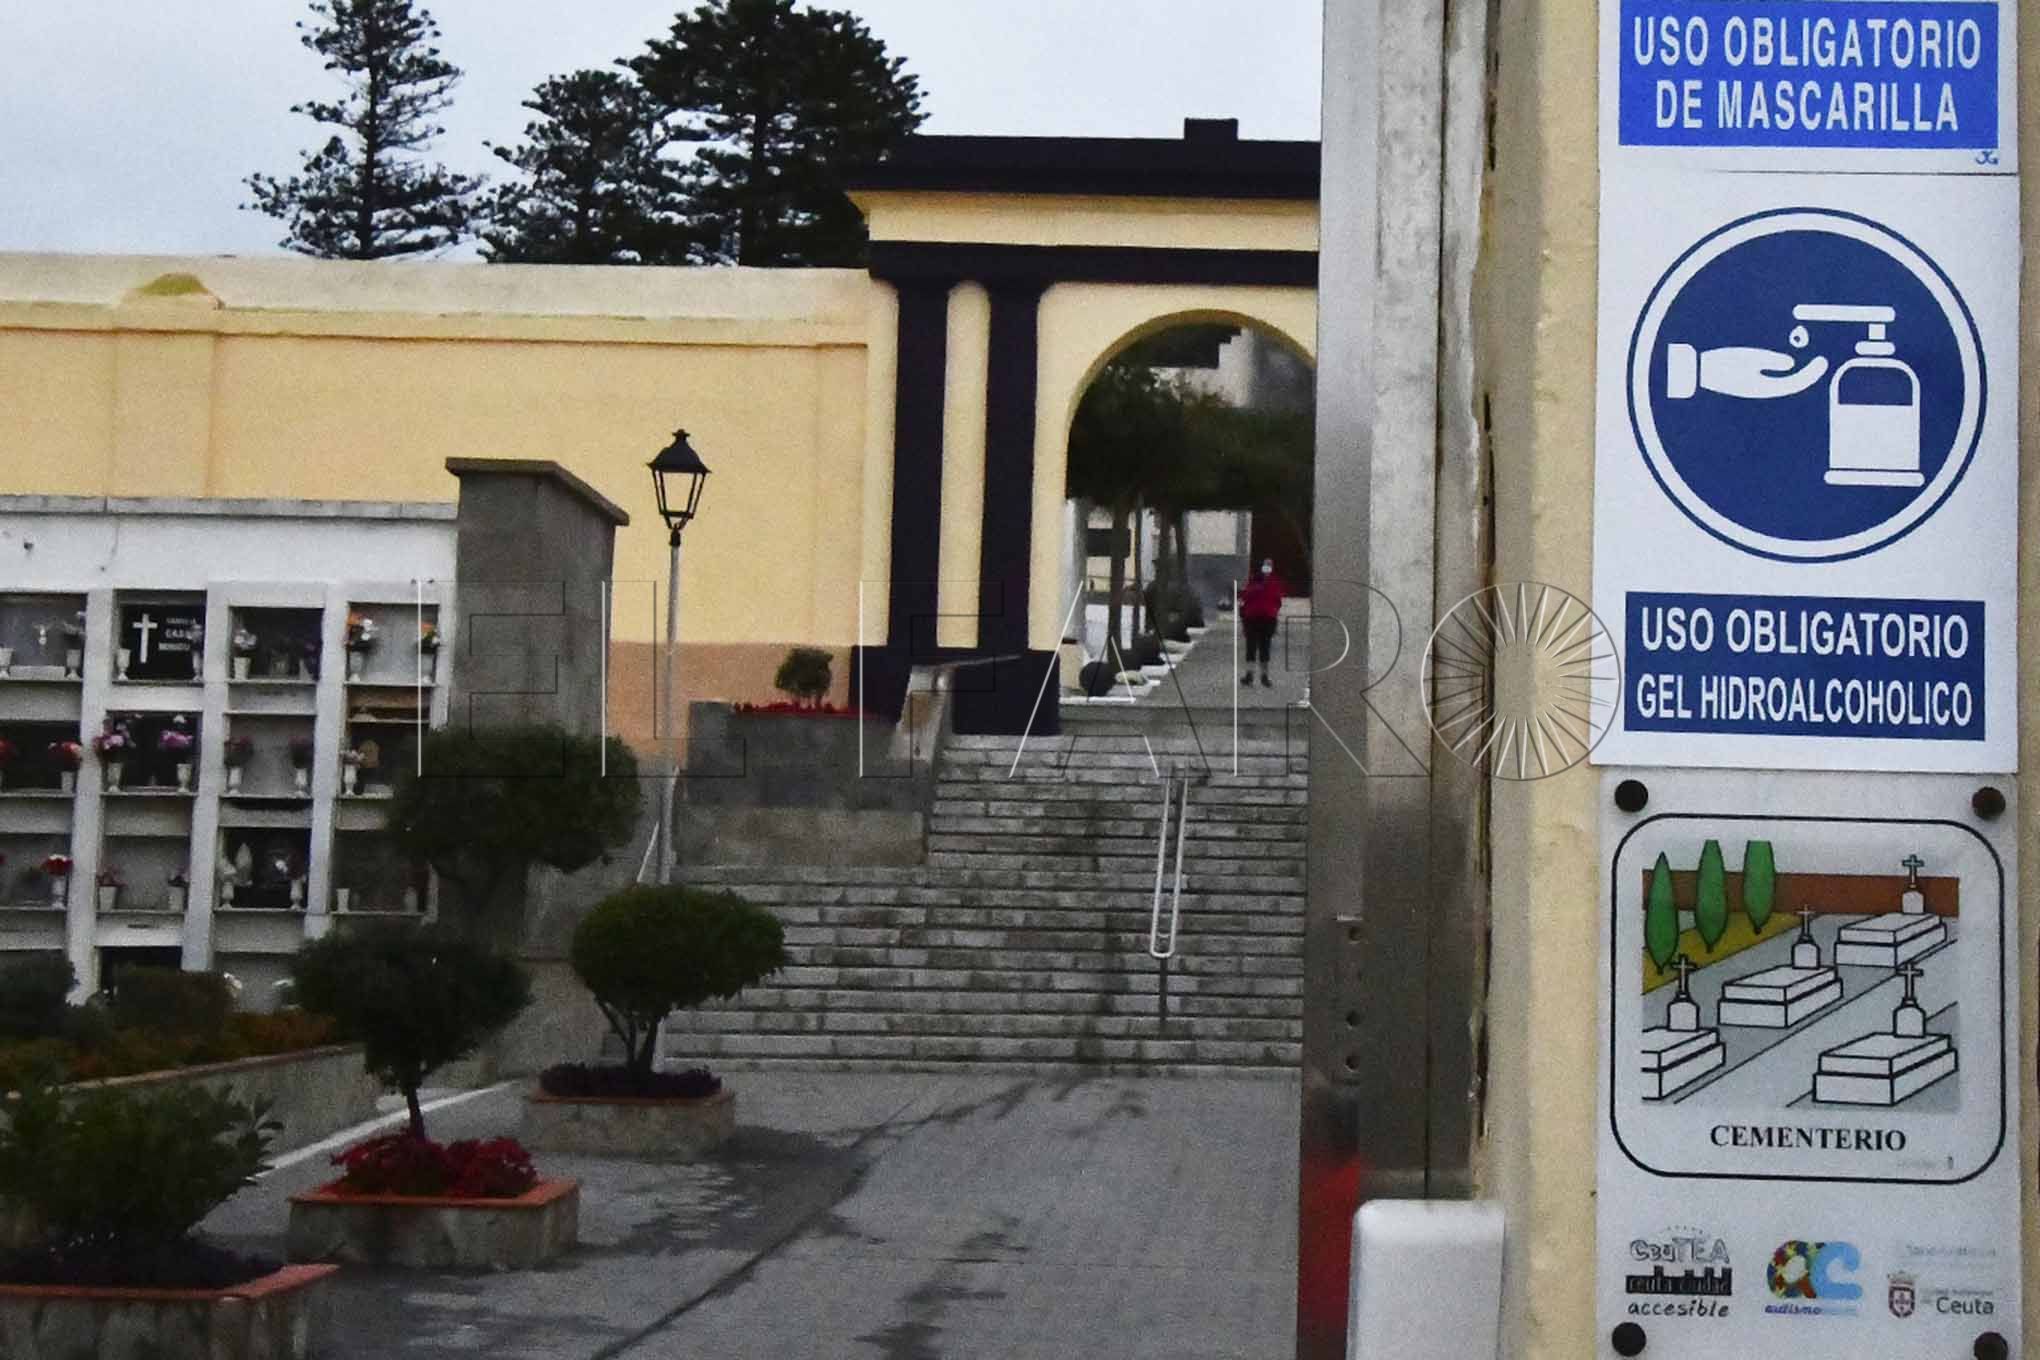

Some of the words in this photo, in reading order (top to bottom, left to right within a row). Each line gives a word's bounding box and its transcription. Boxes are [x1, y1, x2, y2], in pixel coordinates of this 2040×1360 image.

[1633, 15, 1709, 67] USO
[1723, 16, 1982, 69] OBLIGATORIO
[1655, 79, 1704, 129] DE
[1717, 80, 1960, 132] MASCARILLA
[1640, 606, 1714, 652] USO
[1725, 608, 1970, 659] OBLIGATORIO
[1636, 673, 1693, 719] GEL
[1700, 674, 1973, 727] HIDROALCOHOLICO
[1709, 1124, 1907, 1152] CEMENTERIO
[1627, 1299, 1730, 1317] accesible
[1935, 1296, 1995, 1315] Ceuta
